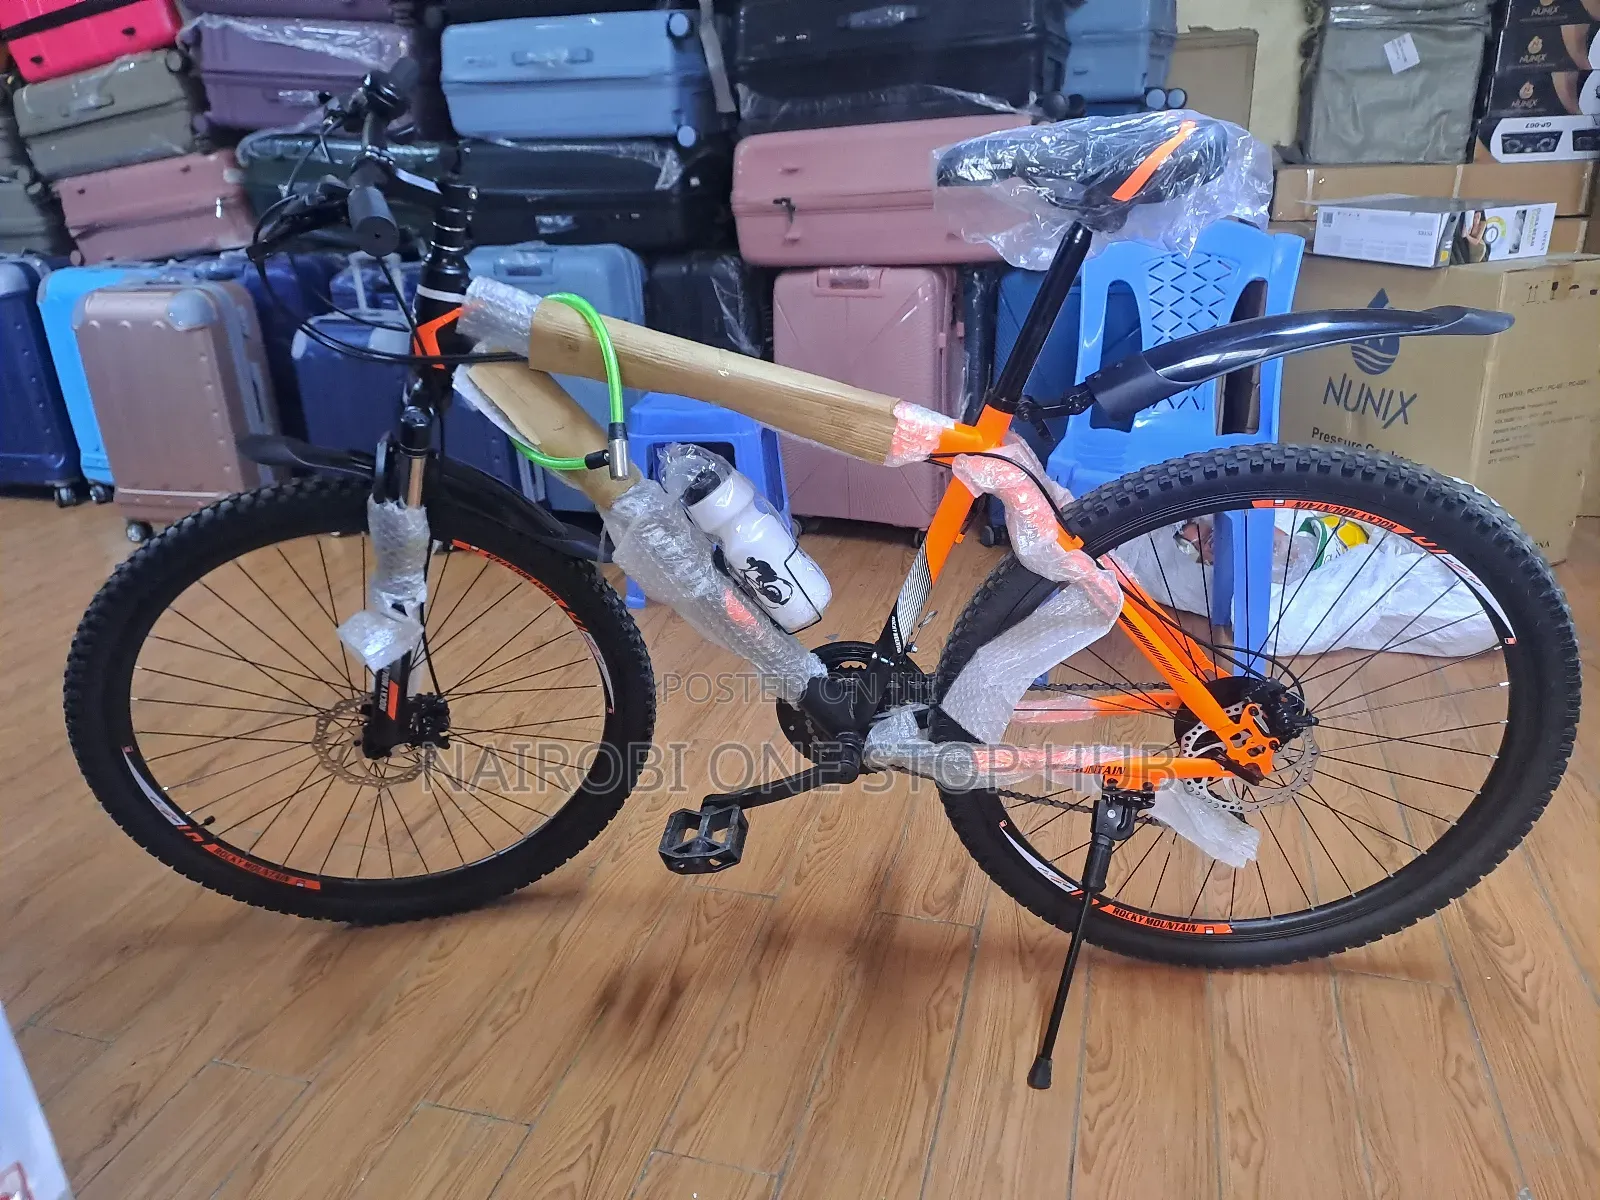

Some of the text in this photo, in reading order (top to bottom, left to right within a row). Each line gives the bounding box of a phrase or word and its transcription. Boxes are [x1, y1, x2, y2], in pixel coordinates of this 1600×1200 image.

[1531, 6, 1560, 16] NUNIX
[1519, 53, 1548, 63] NUNIX
[1322, 372, 1418, 430] NUNIX
[1112, 907, 1198, 932] ROCKY MOUNTAIN
